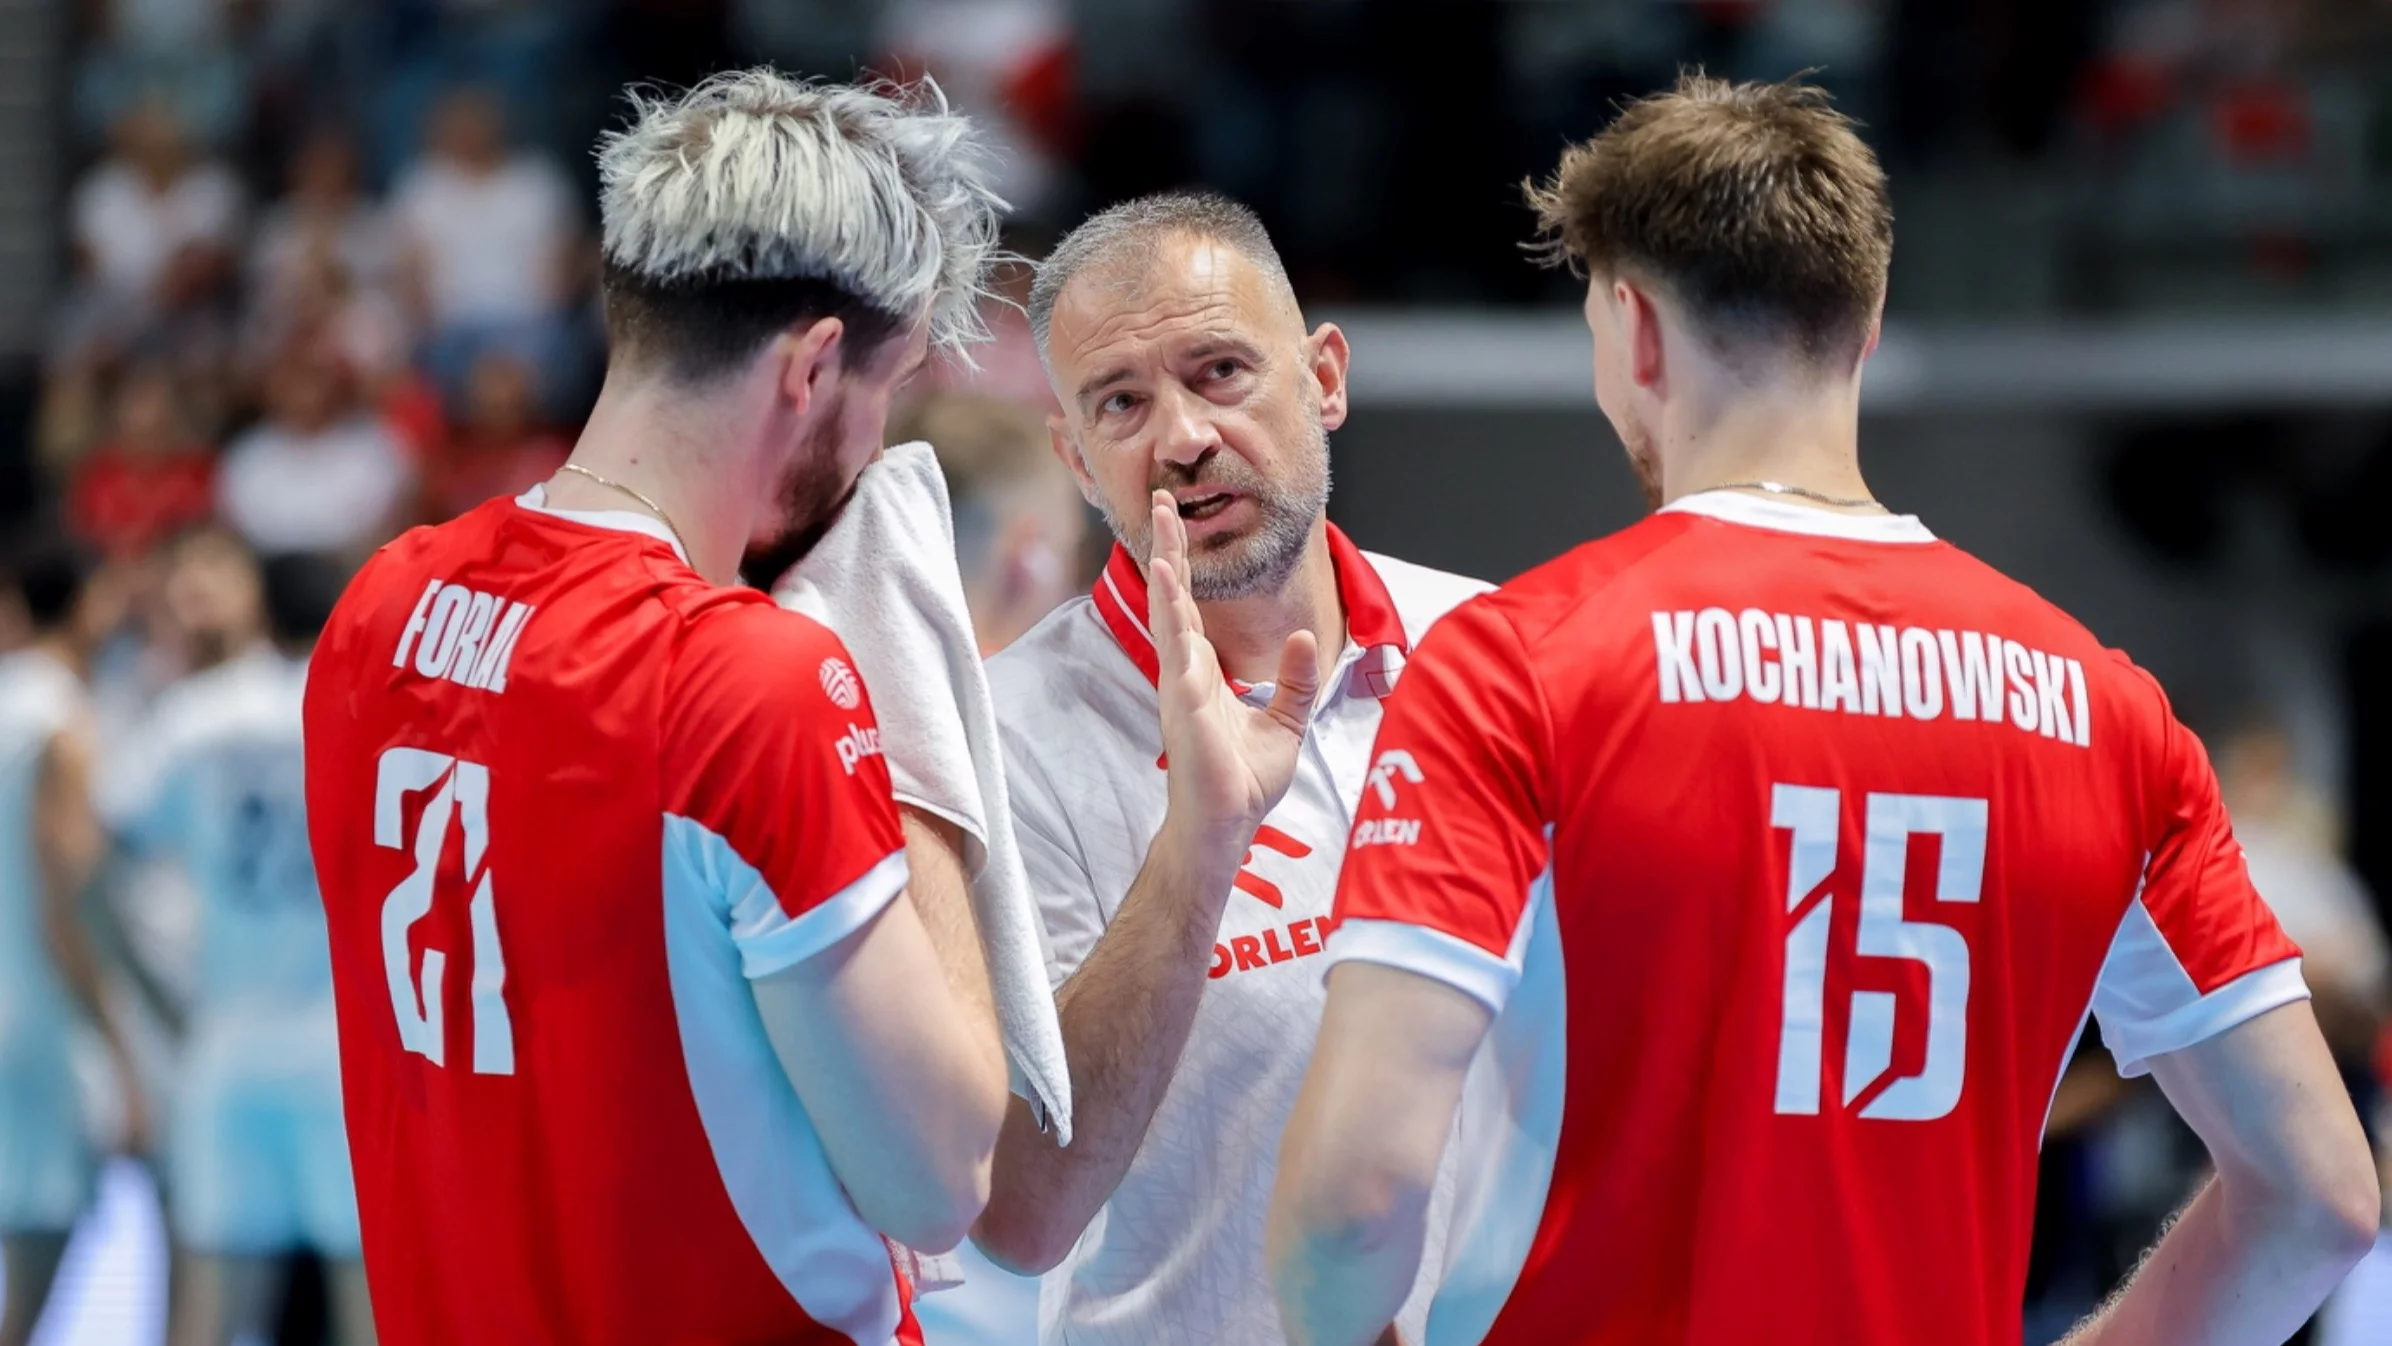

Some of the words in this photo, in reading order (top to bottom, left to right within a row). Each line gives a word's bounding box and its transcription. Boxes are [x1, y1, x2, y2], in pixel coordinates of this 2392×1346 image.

[1651, 606, 2091, 748] KOCHANOWSKI
[374, 746, 515, 1076] 21
[1769, 782, 1989, 1122] 15
